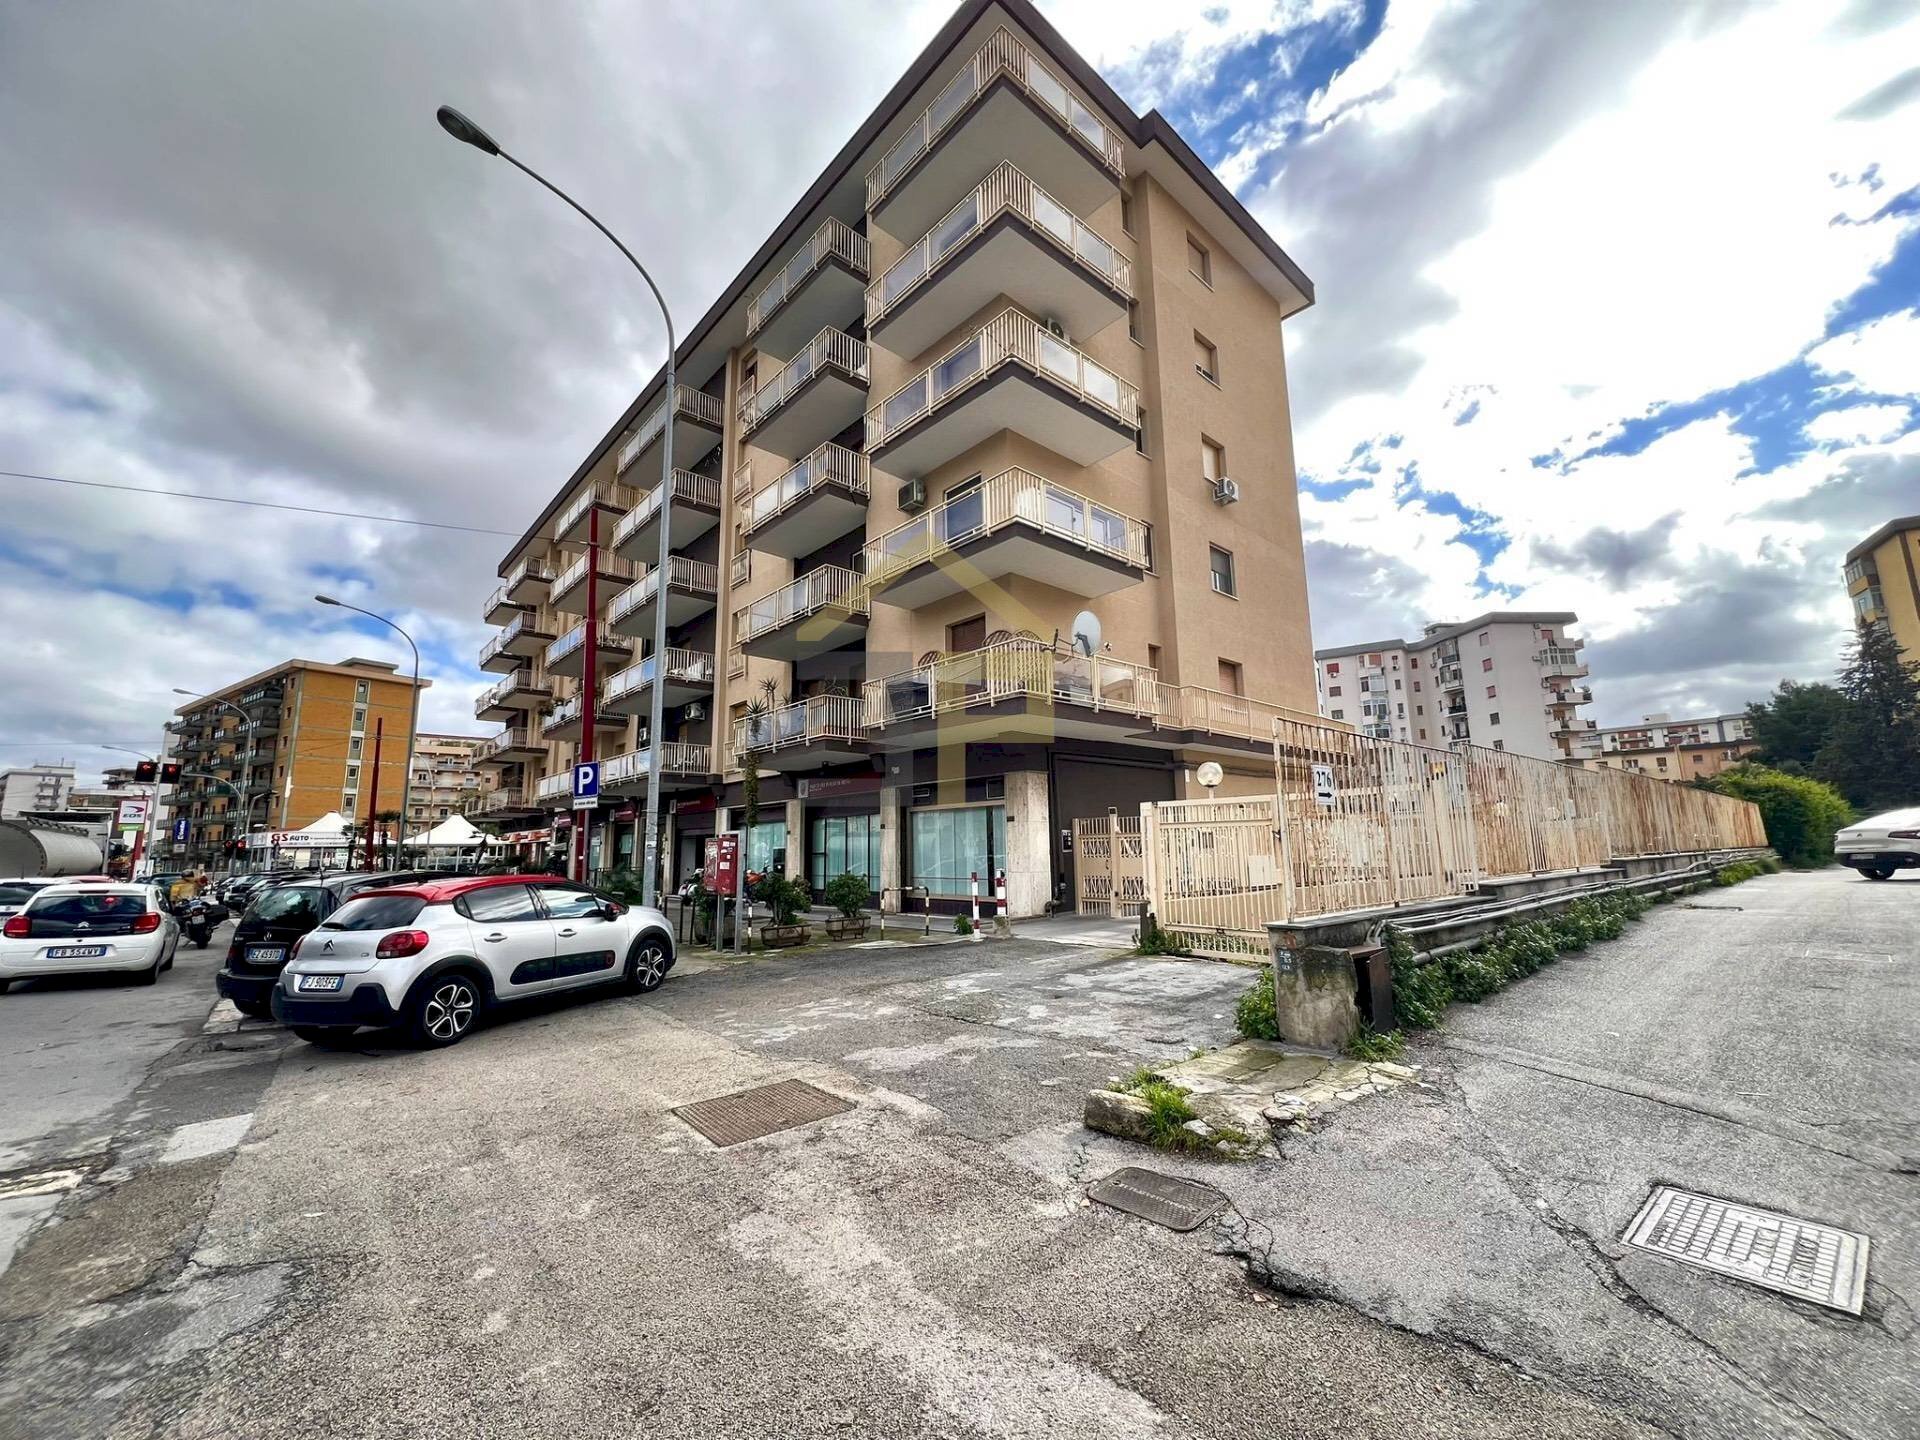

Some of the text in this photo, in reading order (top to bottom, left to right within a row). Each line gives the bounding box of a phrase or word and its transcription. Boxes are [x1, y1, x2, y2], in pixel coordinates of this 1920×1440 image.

[578, 766, 594, 794] P
[1316, 771, 1332, 788] 276
[271, 833, 289, 842] GS
